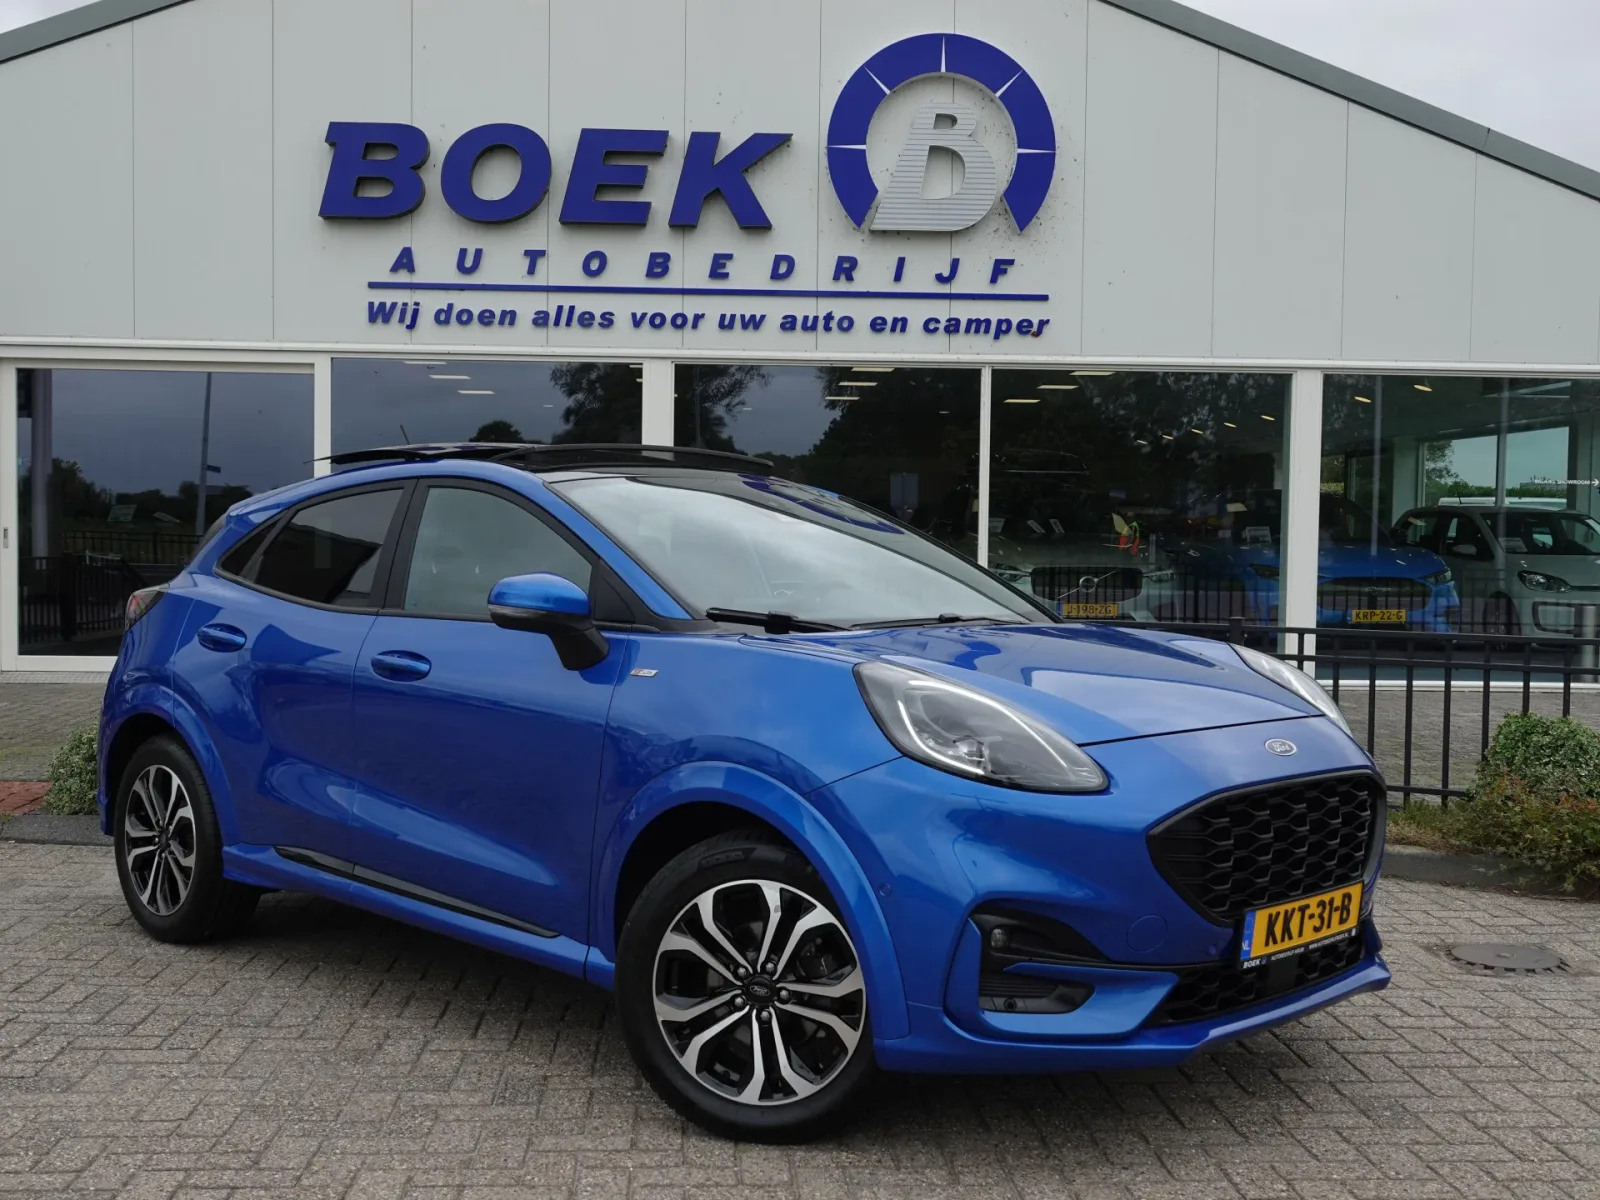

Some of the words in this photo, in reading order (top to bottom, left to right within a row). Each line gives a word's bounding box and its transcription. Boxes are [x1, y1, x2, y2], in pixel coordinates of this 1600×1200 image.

[319, 121, 792, 229] BOEK
[869, 101, 997, 232] B
[389, 247, 1015, 284] AUTOBEDRIJF
[367, 301, 420, 330] Wij
[434, 303, 517, 326] doen
[532, 305, 615, 328] alles
[631, 312, 706, 330] voor
[718, 313, 767, 330] uw
[779, 311, 855, 332] auto
[869, 316, 909, 333] en
[922, 317, 1050, 340] camper
[1355, 610, 1403, 620] KRP-22-G
[1264, 891, 1353, 947] KKT-31-B
[1243, 958, 1261, 969] BOEK
